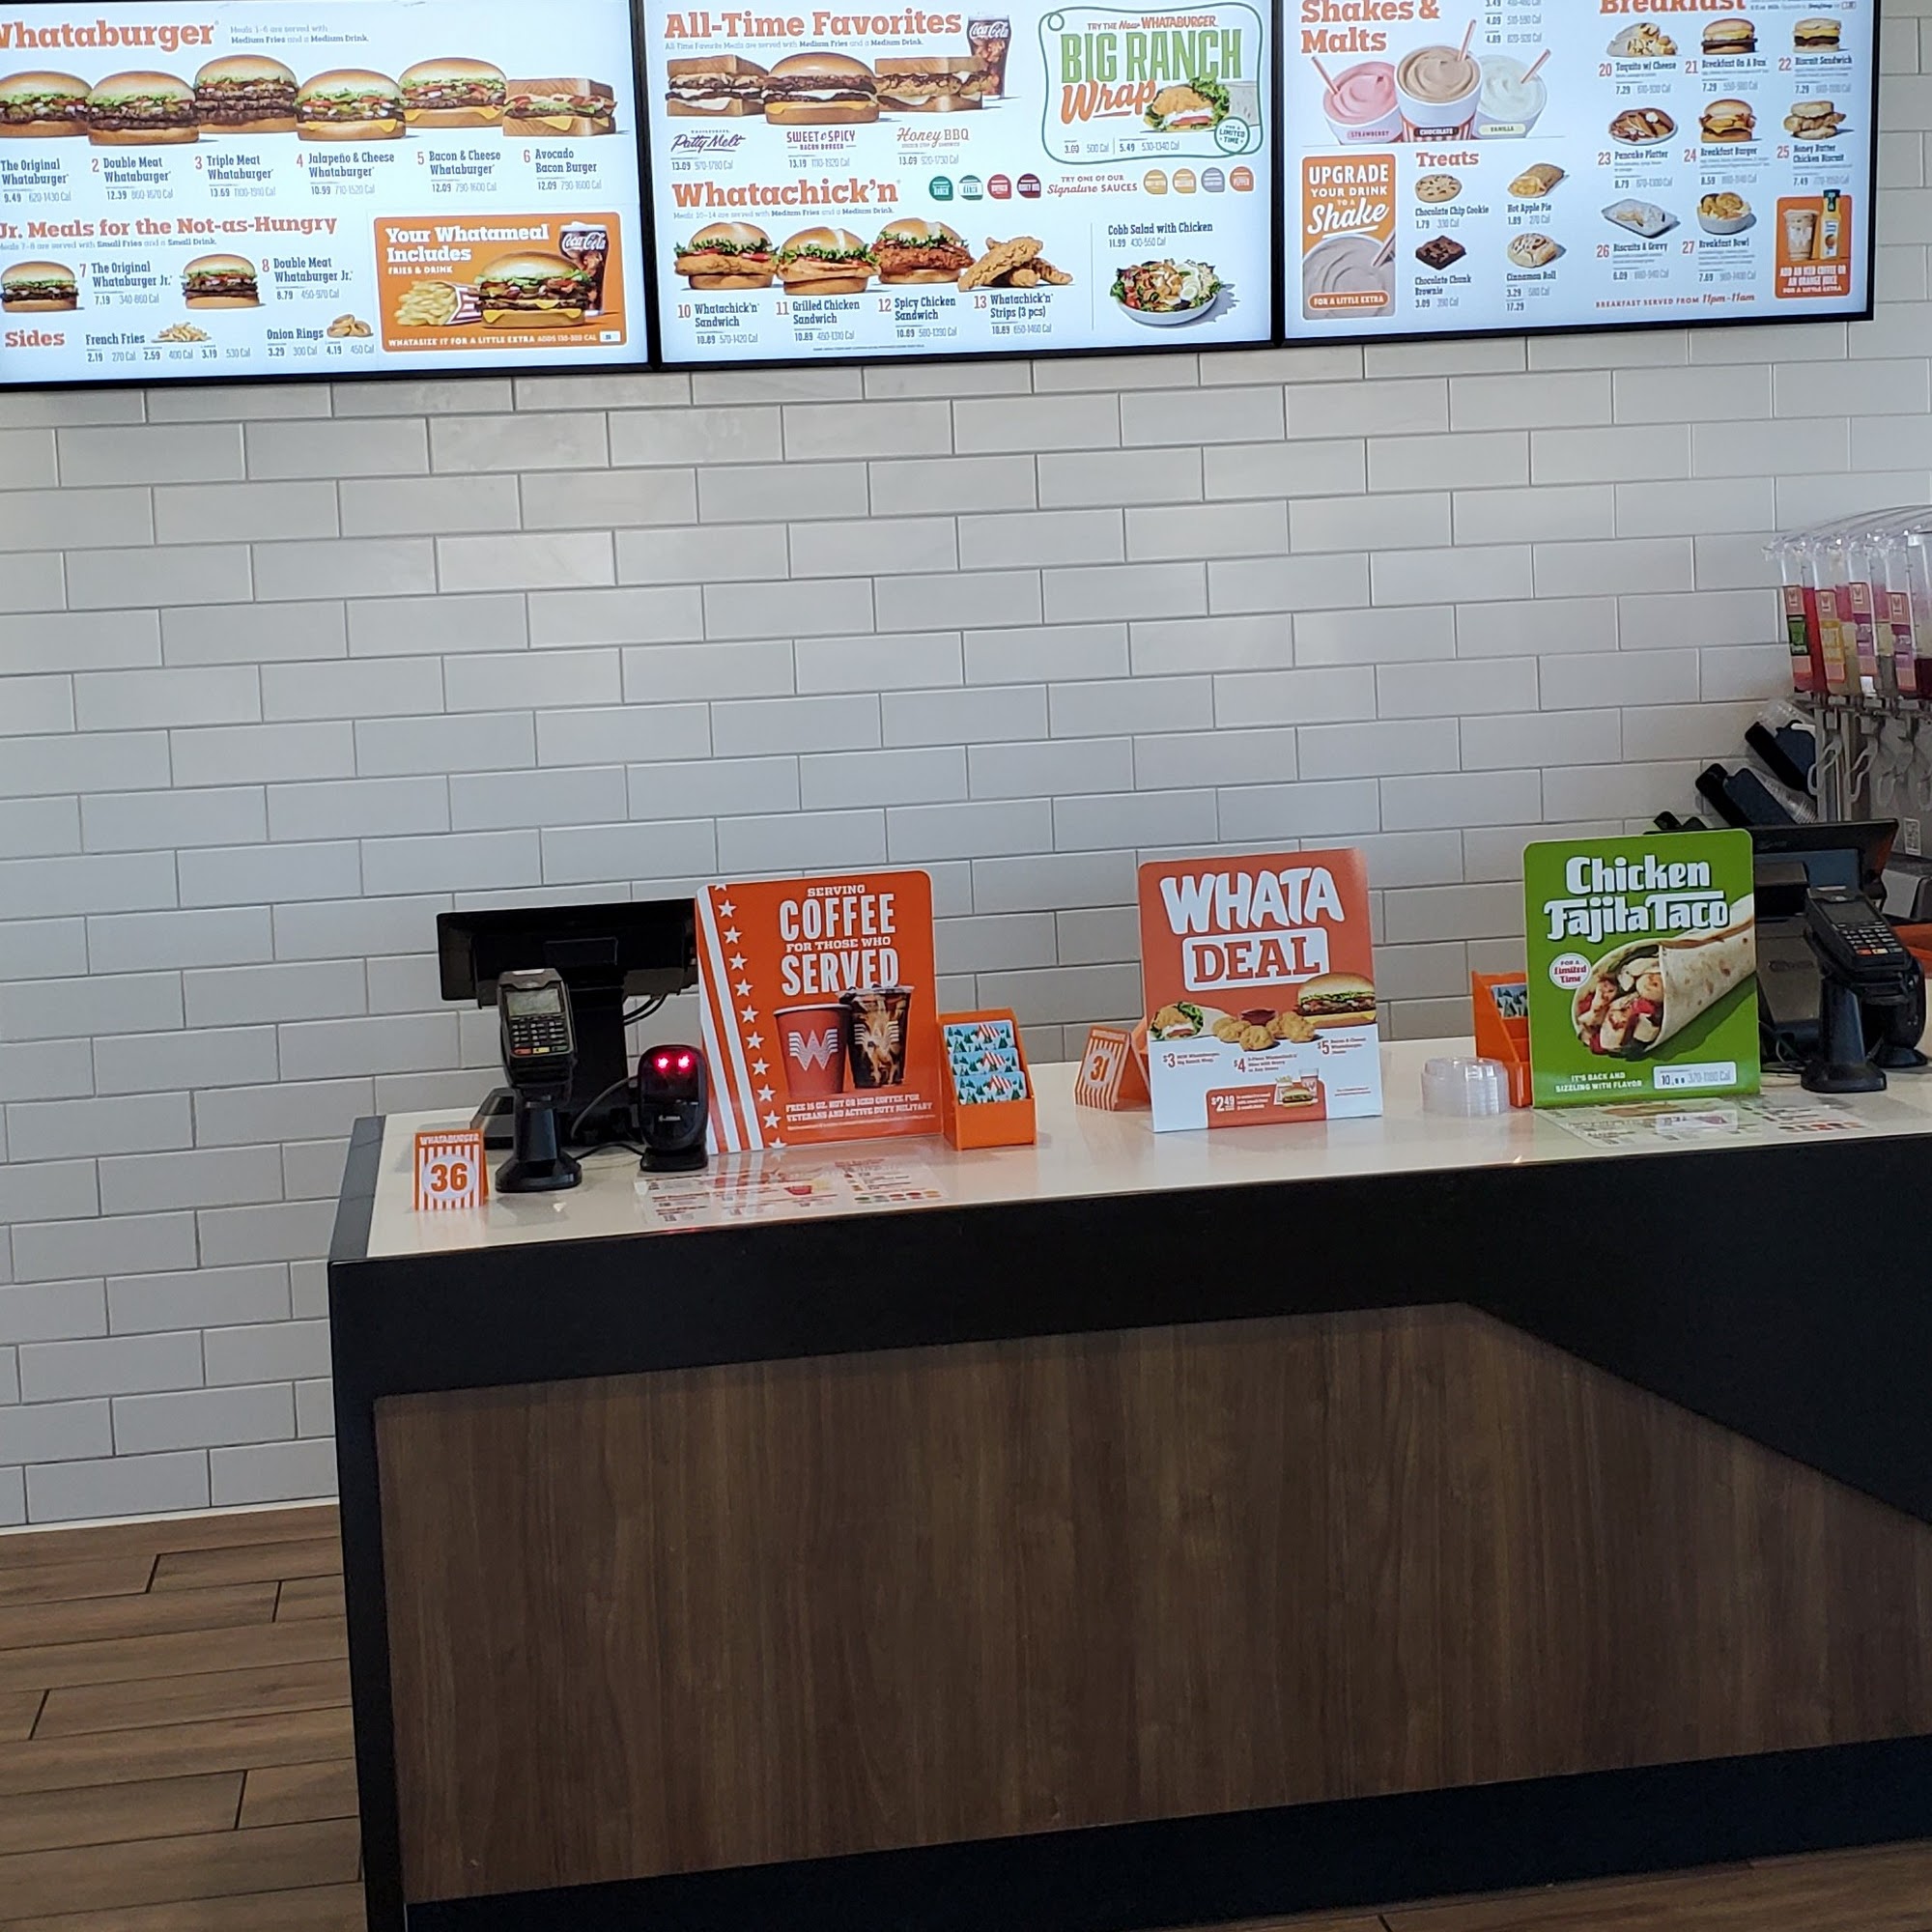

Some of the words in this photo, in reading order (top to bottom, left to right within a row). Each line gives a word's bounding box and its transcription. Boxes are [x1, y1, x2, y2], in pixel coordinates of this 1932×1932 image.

[1300, 0, 1413, 23] Shakes
[1418, 0, 1440, 19] &
[664, 12, 805, 39] All-Time
[811, 8, 962, 37] Favorites
[1087, 22, 1102, 31] TRY
[1103, 21, 1117, 30] THE
[231, 36, 265, 44] Medium
[310, 34, 344, 43] Medium
[1300, 27, 1387, 54] Malts
[1061, 33, 1118, 83] BIG
[1126, 29, 1242, 82] RANCH
[1599, 63, 1612, 76] 20
[1653, 61, 1677, 71] Cheese
[1685, 61, 1698, 74] 21
[1701, 59, 1735, 69] Breakfast
[1778, 58, 1792, 71] 22
[1061, 78, 1156, 125] Wrap
[786, 130, 820, 143] SWEET
[828, 129, 856, 142] SPICY
[896, 128, 943, 148] Honey
[944, 128, 970, 142] BBQ
[1419, 128, 1454, 136] CHOCOLATE
[670, 133, 711, 154] Patty
[417, 152, 425, 165] 5
[429, 150, 458, 162] Bacon
[460, 151, 467, 161] &
[469, 150, 500, 161] Cheese
[524, 150, 531, 163] 6
[535, 149, 575, 159] Avocado
[1598, 152, 1611, 166] 23
[1684, 149, 1697, 162] 24
[1700, 147, 1733, 156] Breakfast
[1735, 147, 1757, 156] Burger
[1776, 145, 1790, 158] 25
[1793, 155, 1820, 163] Chicken
[1, 159, 18, 171] The
[20, 158, 60, 173] Original
[92, 158, 100, 173] 2
[103, 156, 136, 169] Double
[138, 156, 162, 168] Meat
[194, 156, 203, 170] 3
[207, 155, 234, 168] Triple
[237, 155, 260, 166] Meat
[296, 154, 304, 168] 4
[308, 152, 351, 166] Jalapeño
[353, 153, 359, 162] &
[361, 152, 394, 162] Cheese
[1415, 152, 1480, 168] Treats
[536, 162, 564, 173] Bacon
[566, 162, 597, 174] Burger
[1309, 164, 1389, 185] UPGRADE
[107, 190, 128, 200] 12.39
[671, 178, 899, 208] Whatachick'n
[1046, 184, 1098, 198] Signature
[1100, 183, 1138, 193] SAUCES
[1311, 188, 1345, 198] YOUR
[1349, 186, 1388, 196] DRINK
[1450, 206, 1465, 217] Chip
[1466, 205, 1490, 214] Cookie
[1507, 204, 1520, 213] Hot
[1520, 203, 1540, 213] Apple
[1541, 203, 1551, 212] Pie
[1307, 197, 1390, 235] Shake
[27, 219, 95, 238] Meals
[99, 218, 130, 236] for
[135, 217, 172, 235] the
[177, 215, 337, 235] Not-as-Hungry
[385, 226, 431, 244] Your
[436, 223, 550, 242] Whatameal
[1108, 224, 1128, 236] Cobb
[1130, 223, 1154, 235] Salad
[1156, 223, 1177, 234] with
[1178, 221, 1213, 233] Chicken
[1596, 244, 1609, 258] 26
[1682, 241, 1695, 254] 27
[1698, 239, 1732, 248] Breakfast
[387, 246, 472, 264] Includes
[79, 264, 87, 277] 7
[92, 262, 109, 274] The
[111, 261, 151, 275] Original
[262, 259, 270, 272] 8
[273, 256, 306, 270] Double
[308, 257, 332, 269] Meat
[93, 275, 156, 289] Whataburger
[159, 275, 172, 287] Jr.
[274, 270, 338, 284] Whataburger
[340, 270, 352, 281] Jr.
[1450, 274, 1471, 284] Chunk
[776, 301, 790, 316] 11
[792, 299, 821, 312] Grilled
[823, 298, 860, 311] Chicken
[878, 298, 892, 312] 12
[895, 297, 920, 309] Spicy
[921, 295, 956, 307] Chicken
[974, 295, 987, 309] 13
[1596, 299, 1641, 308] BREAKFAST
[1643, 298, 1674, 306] SERVED
[677, 304, 692, 319] 10
[793, 312, 838, 325] Sandwich
[895, 309, 939, 321] Sandwich
[990, 306, 1016, 320] Strips
[695, 316, 740, 327] Sandwich
[5, 329, 66, 348] Sides
[85, 332, 120, 345] French
[121, 332, 146, 345] Fries
[266, 328, 294, 340] Onion
[296, 327, 325, 341] Rings
[87, 353, 103, 362] 2.19
[144, 351, 161, 361] 2.59
[201, 348, 218, 358] 3.19
[268, 346, 285, 357] 3.29
[326, 345, 342, 355] 4.19
[1564, 854, 1711, 895] Chicken
[807, 884, 867, 897] SERVING
[1159, 866, 1346, 935] WHATA
[779, 893, 896, 942] COFFEE
[1543, 895, 1649, 944] Fajita
[1645, 890, 1729, 930] Taco
[785, 940, 812, 953] FOR
[814, 938, 859, 952] THOSE
[861, 936, 892, 948] WHO
[1191, 936, 1321, 984] DEAL
[781, 948, 899, 997] SERVED
[1587, 1072, 1607, 1082] BACK
[1609, 1071, 1626, 1080] AND
[1555, 1083, 1591, 1094] SIZZLING
[1592, 1082, 1611, 1091] WITH
[1612, 1080, 1642, 1090] FLAVOR
[875, 1094, 904, 1104] COFFEE
[844, 1108, 873, 1118] ACTIVE
[895, 1102, 933, 1113] MILITARY
[431, 1162, 468, 1192] 36
